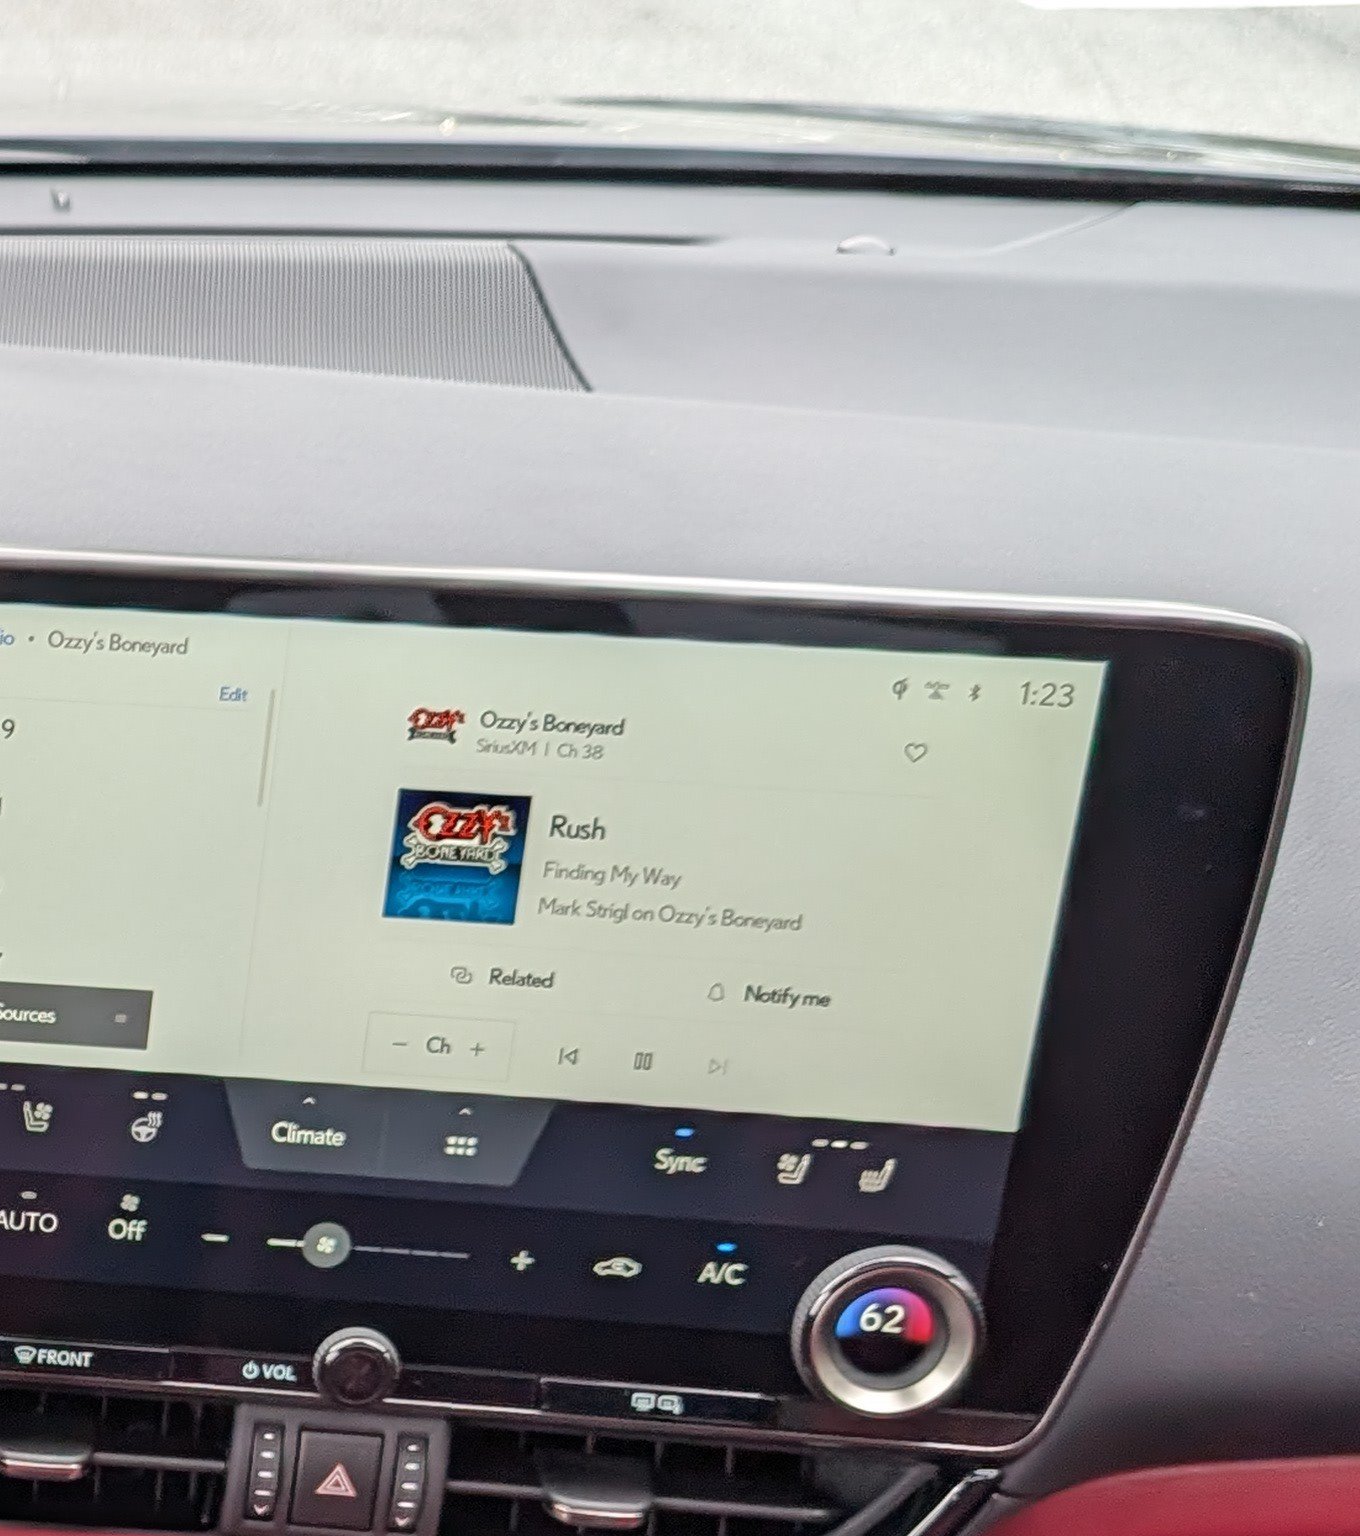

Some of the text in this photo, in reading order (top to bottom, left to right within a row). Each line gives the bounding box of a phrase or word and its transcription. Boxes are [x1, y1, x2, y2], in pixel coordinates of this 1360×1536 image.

[48, 630, 104, 654] Ozzy's
[109, 633, 189, 657] Boneyard
[218, 686, 248, 703] Edit
[1019, 680, 1076, 709] 1:23
[480, 710, 627, 738] Ozzy's Boneyard
[475, 737, 605, 761] SiriusXM Ch 38
[548, 813, 607, 842] Rush
[542, 860, 683, 891] Finding My Way
[537, 896, 803, 934] Mark Strigl on Ozzy's Boneyard
[488, 967, 556, 989] Related
[743, 984, 833, 1009] Notify me
[426, 1036, 451, 1054] Ch
[270, 1121, 347, 1148] Climate
[653, 1147, 708, 1177] Sync
[107, 1217, 148, 1242] Off
[696, 1260, 747, 1287] A/C
[859, 1303, 906, 1335] 62
[37, 1348, 95, 1369] FRONT
[260, 1363, 298, 1383] VOL
